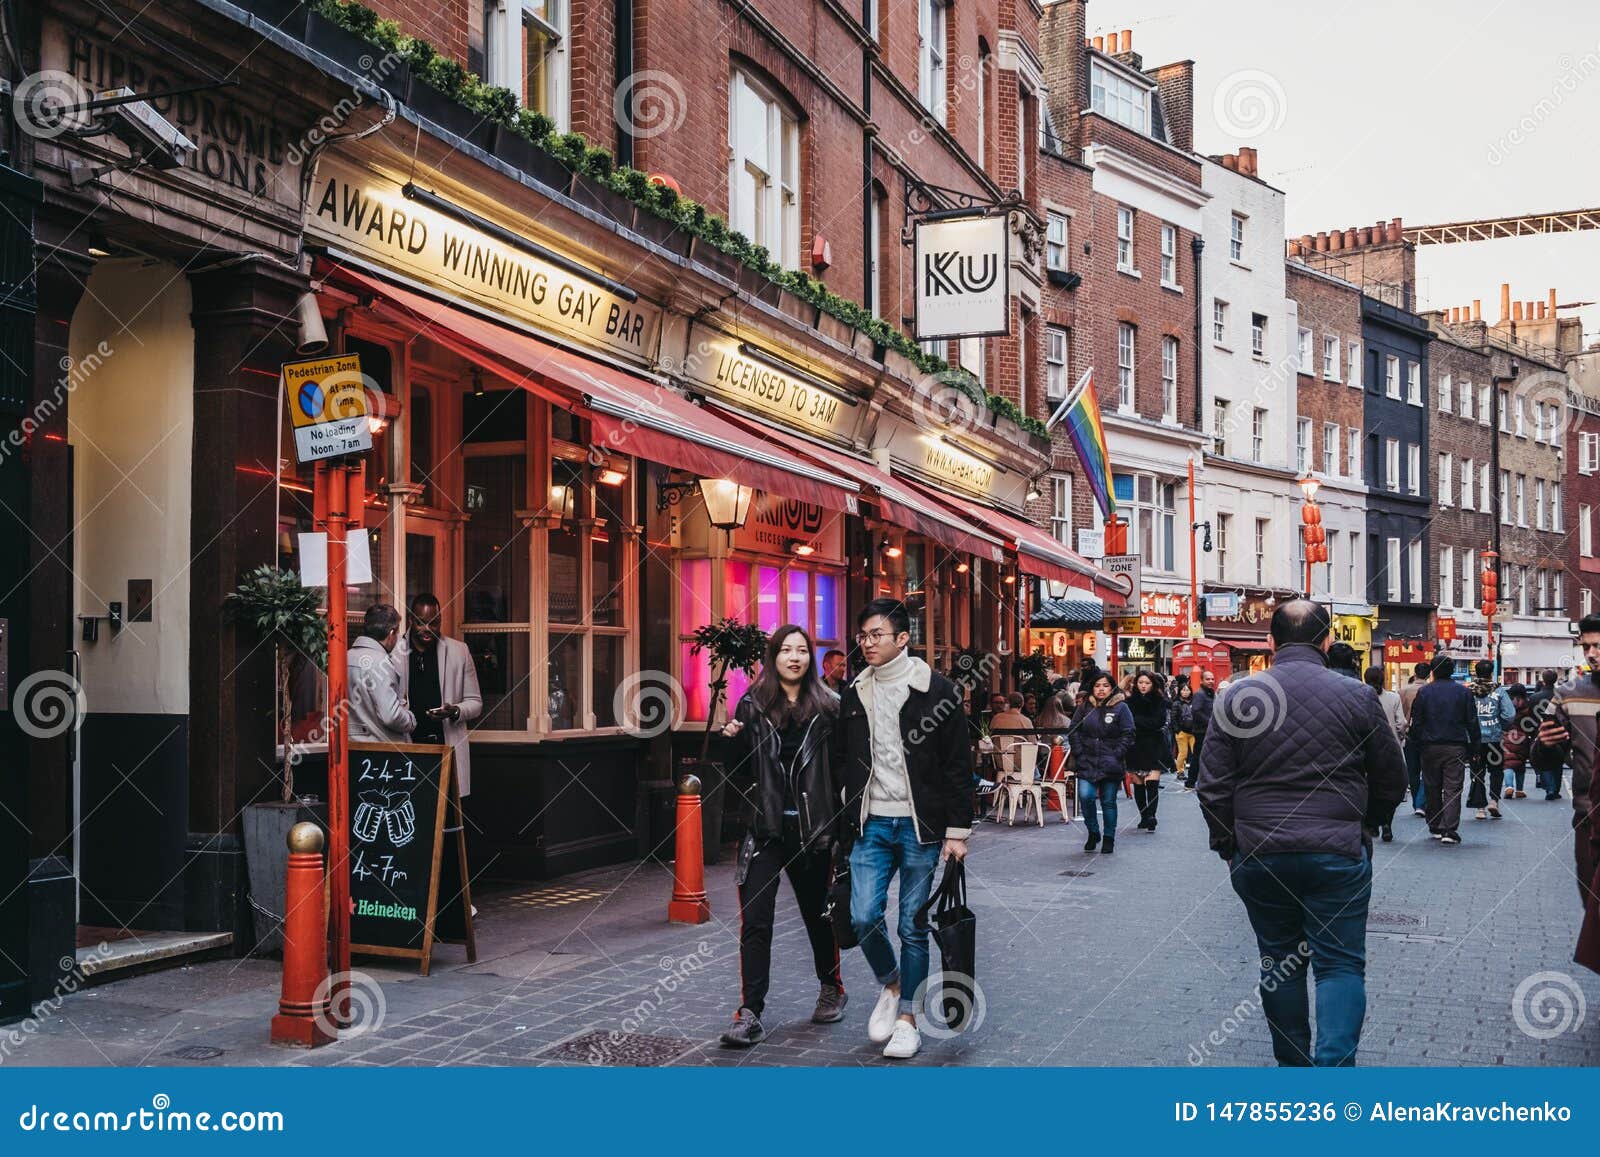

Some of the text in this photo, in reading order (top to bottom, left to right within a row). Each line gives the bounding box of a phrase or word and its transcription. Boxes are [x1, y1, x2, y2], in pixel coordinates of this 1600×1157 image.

[317, 178, 645, 347] AWARD WINNING GAY BAR
[925, 252, 998, 297] KU
[288, 361, 357, 378] Pedestrian Zone
[329, 383, 357, 394] At any
[716, 354, 838, 424] LICENSED TO 3AM
[336, 396, 355, 407] time
[310, 424, 356, 440] No loading
[310, 444, 334, 455] Noon
[342, 439, 360, 449] 7am
[755, 529, 794, 547] LEICEST
[1106, 556, 1137, 564] PEDESTRIAN
[1110, 563, 1133, 572] ZONE
[1146, 616, 1176, 627] MEDICINE
[358, 758, 416, 783] 2-4-1
[357, 898, 417, 920] Heineken
